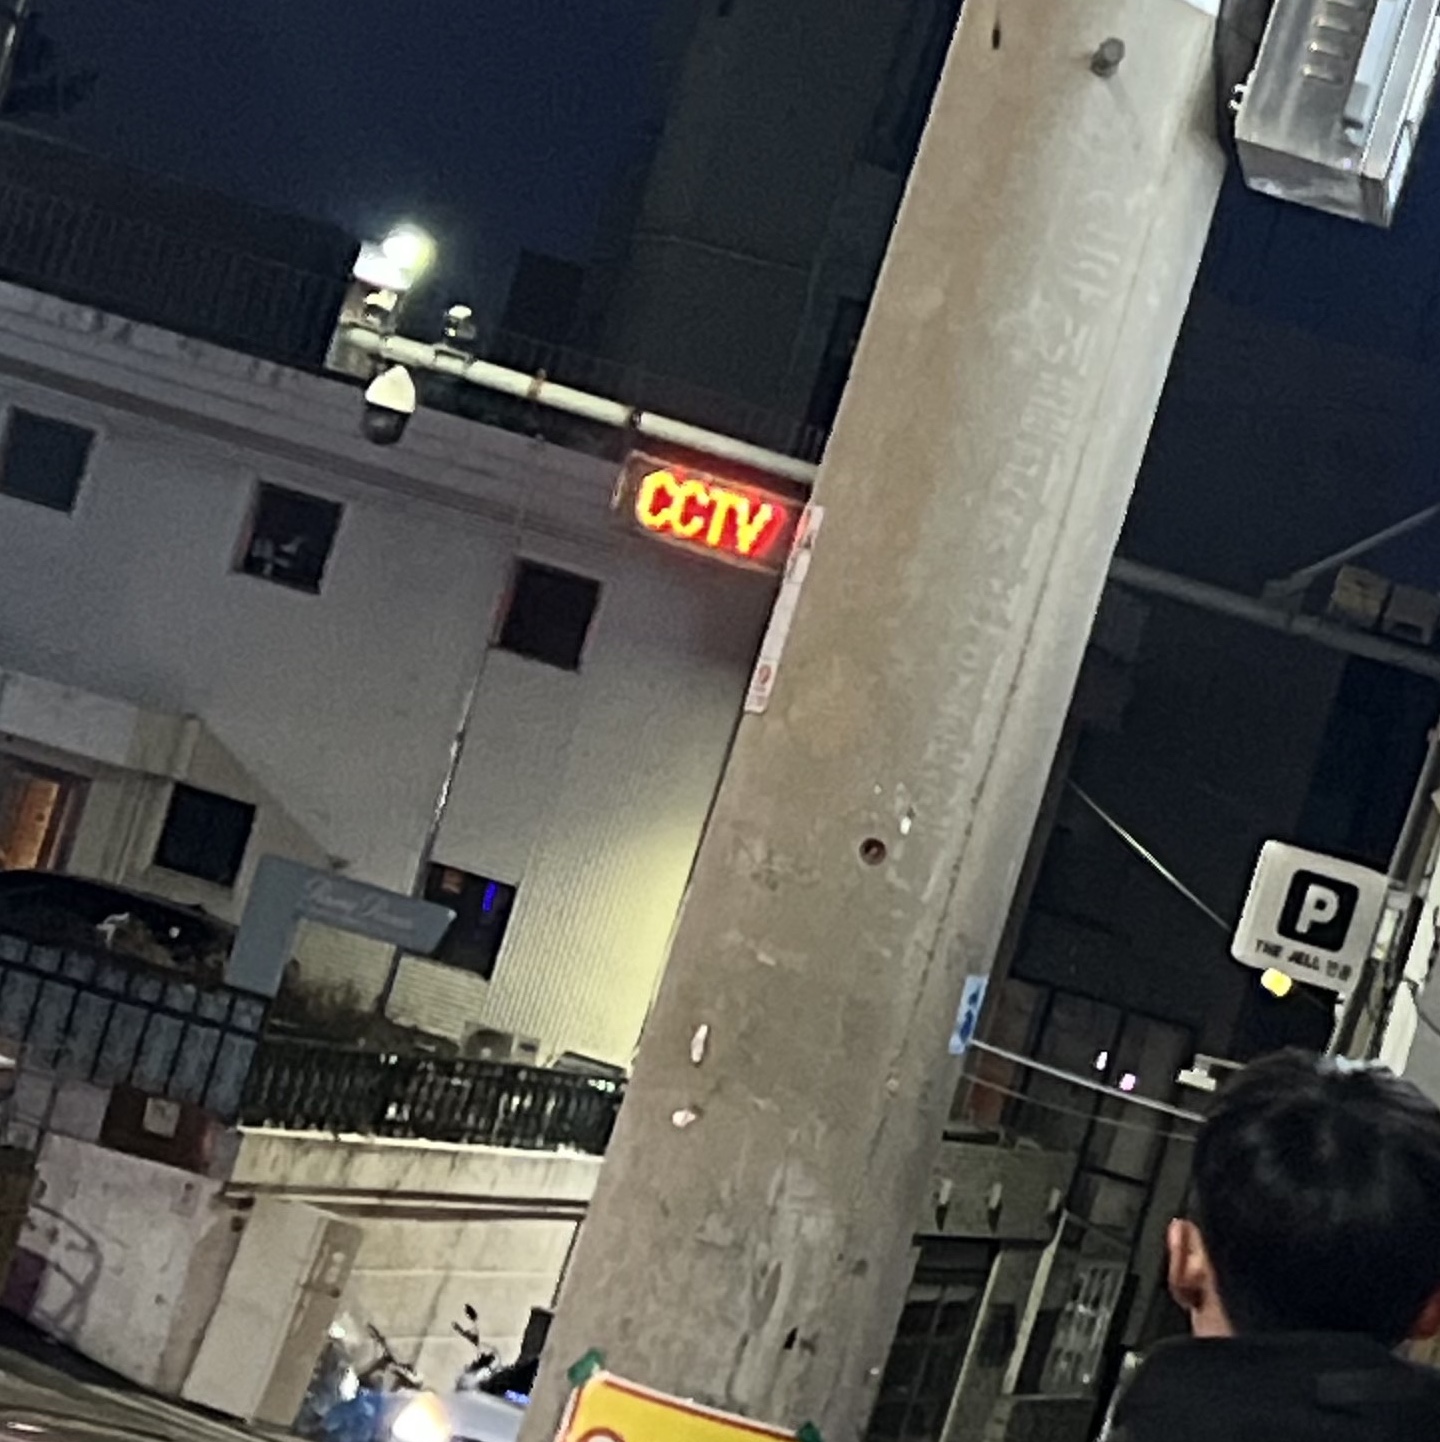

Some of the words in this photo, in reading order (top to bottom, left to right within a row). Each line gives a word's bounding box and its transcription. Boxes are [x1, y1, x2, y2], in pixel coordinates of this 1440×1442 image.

[635, 469, 773, 554] CCTV
[1294, 882, 1340, 934] P
[1255, 939, 1283, 959] THE
